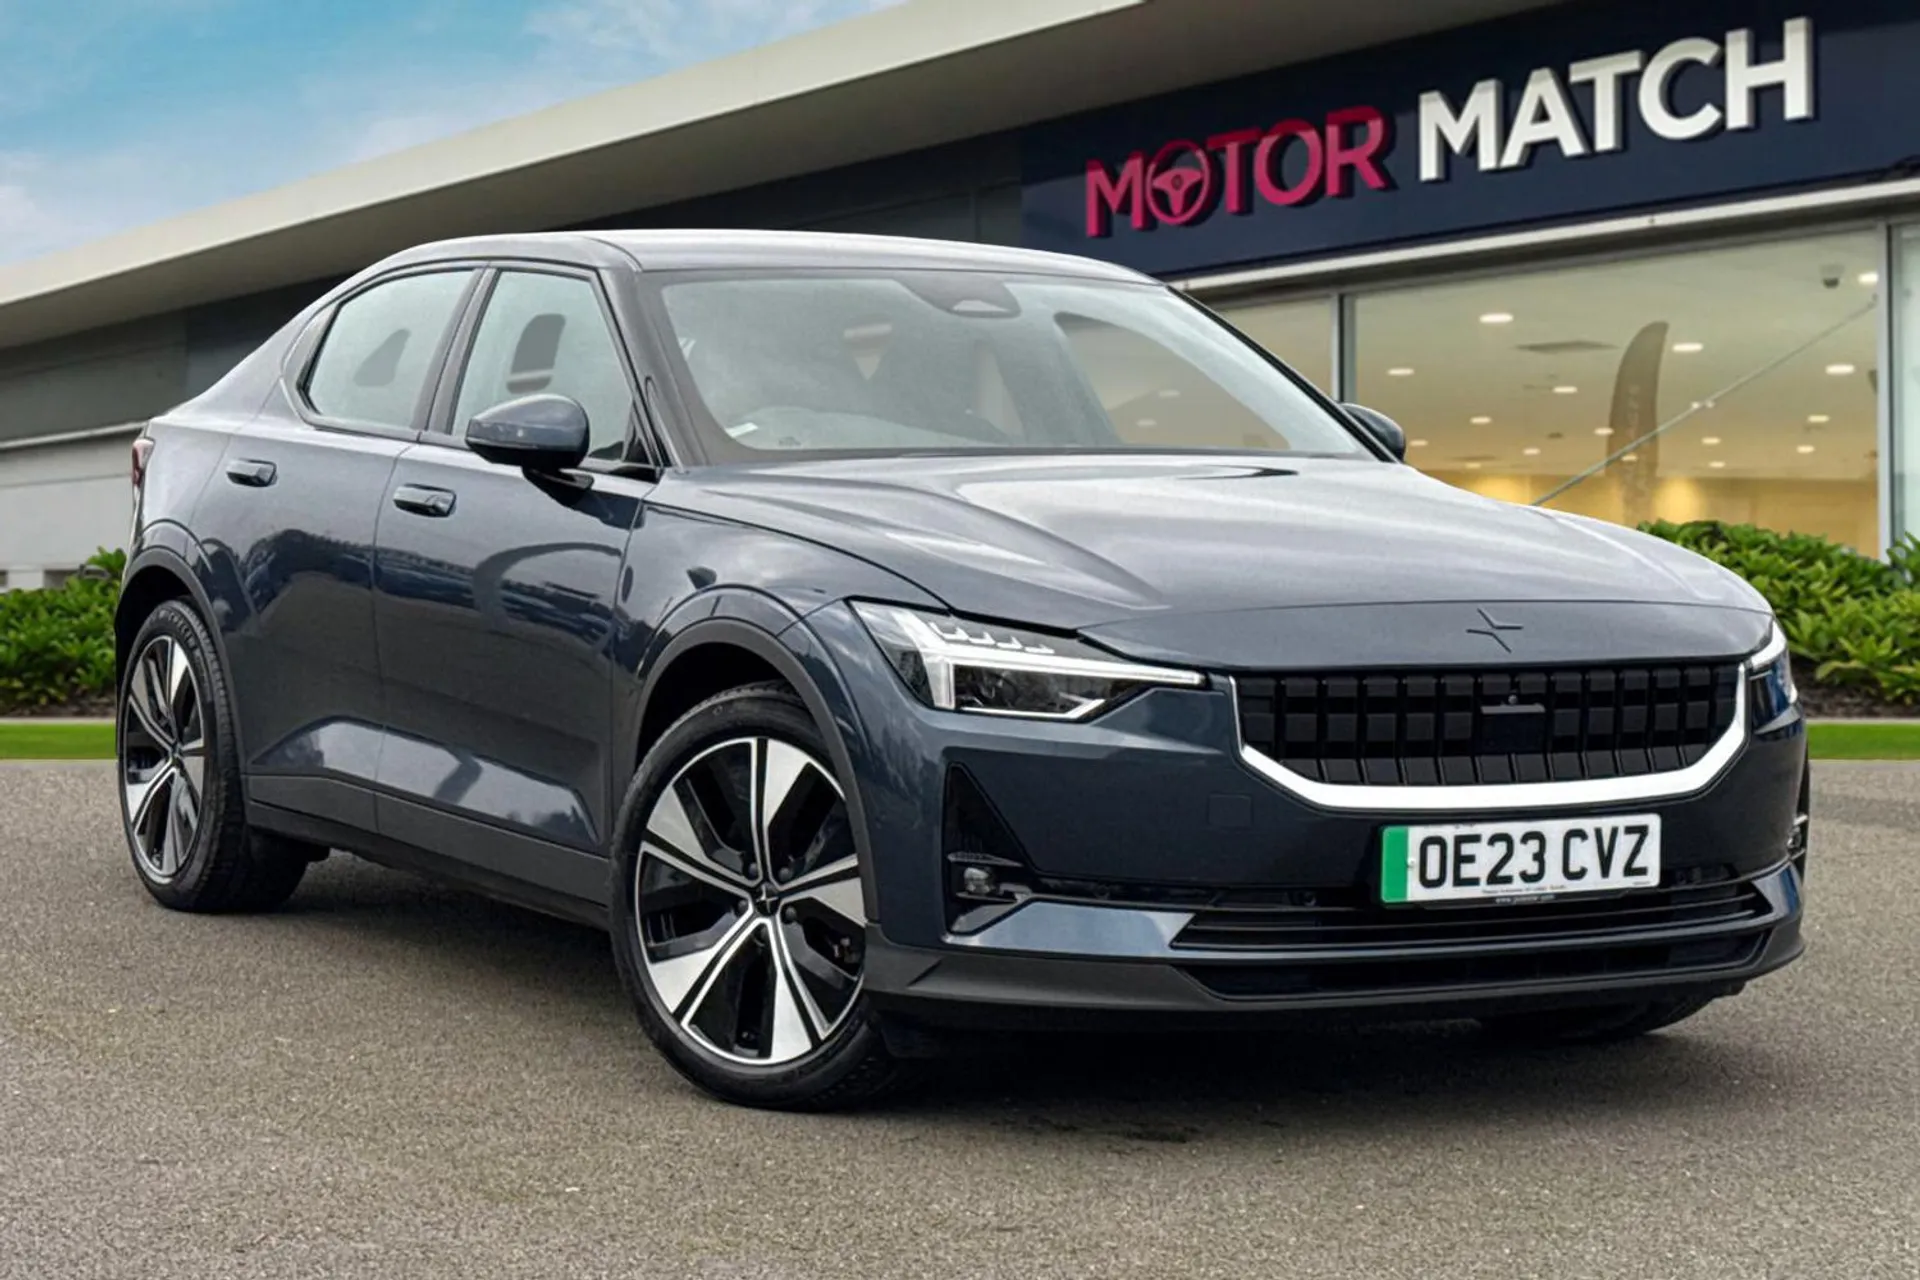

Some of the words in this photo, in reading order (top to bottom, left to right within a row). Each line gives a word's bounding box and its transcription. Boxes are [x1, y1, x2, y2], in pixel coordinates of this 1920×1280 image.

[1086, 105, 1387, 237] MOTOR
[1419, 16, 1813, 182] MATCH
[1419, 831, 1547, 889] OE23
[1562, 824, 1650, 881] CVZ
